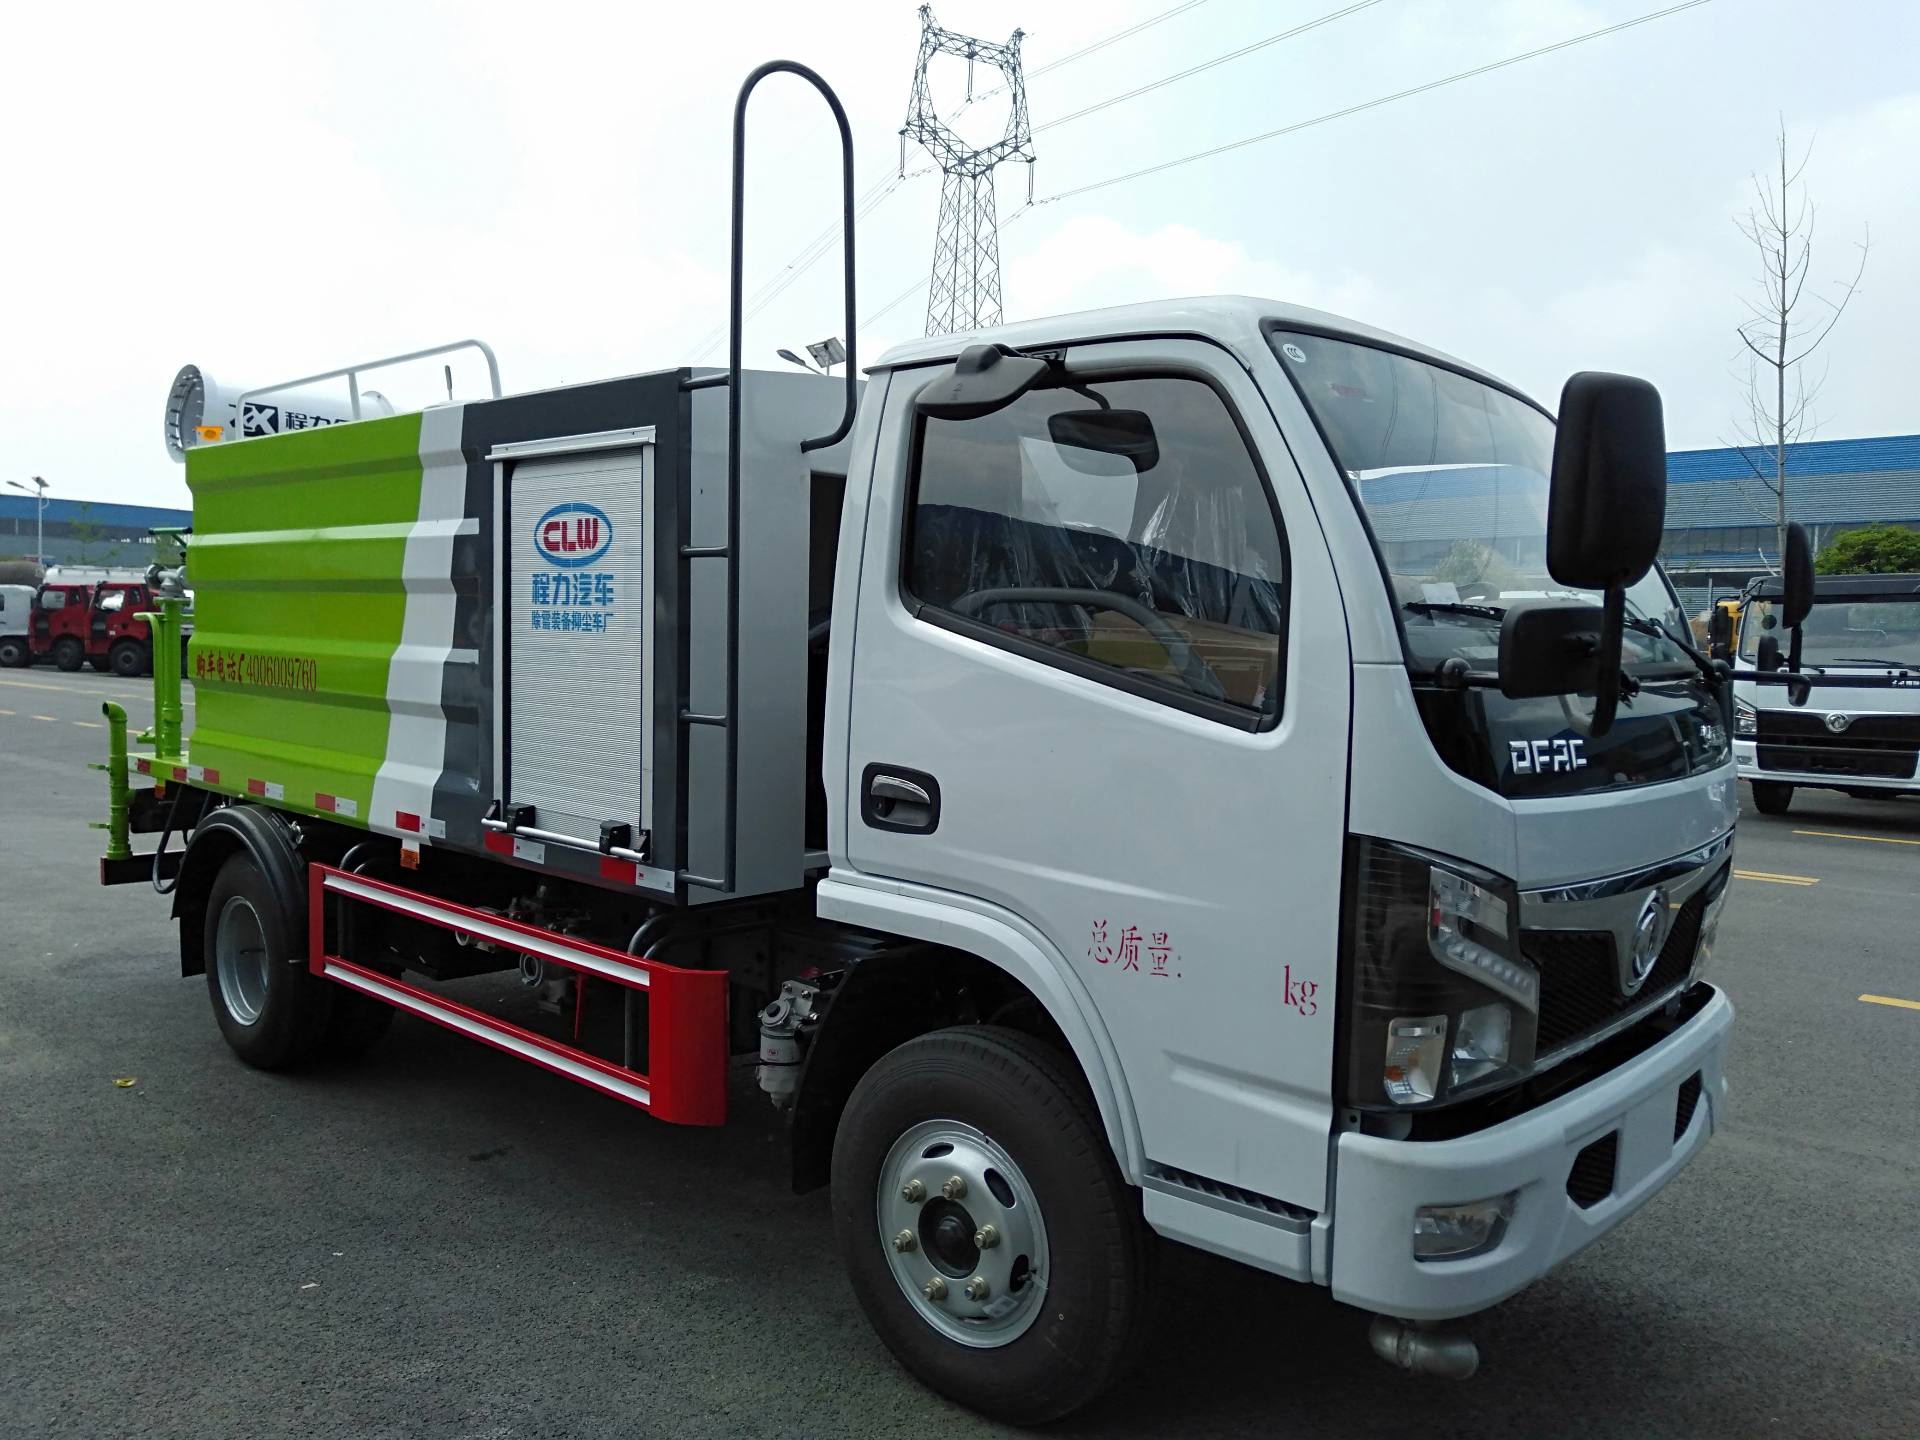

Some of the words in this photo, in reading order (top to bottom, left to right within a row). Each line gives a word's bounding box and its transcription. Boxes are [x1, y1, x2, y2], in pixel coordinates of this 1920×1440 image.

[543, 518, 599, 552] CLW
[531, 572, 614, 606] 程力汽车
[1283, 964, 1319, 1016] kg
